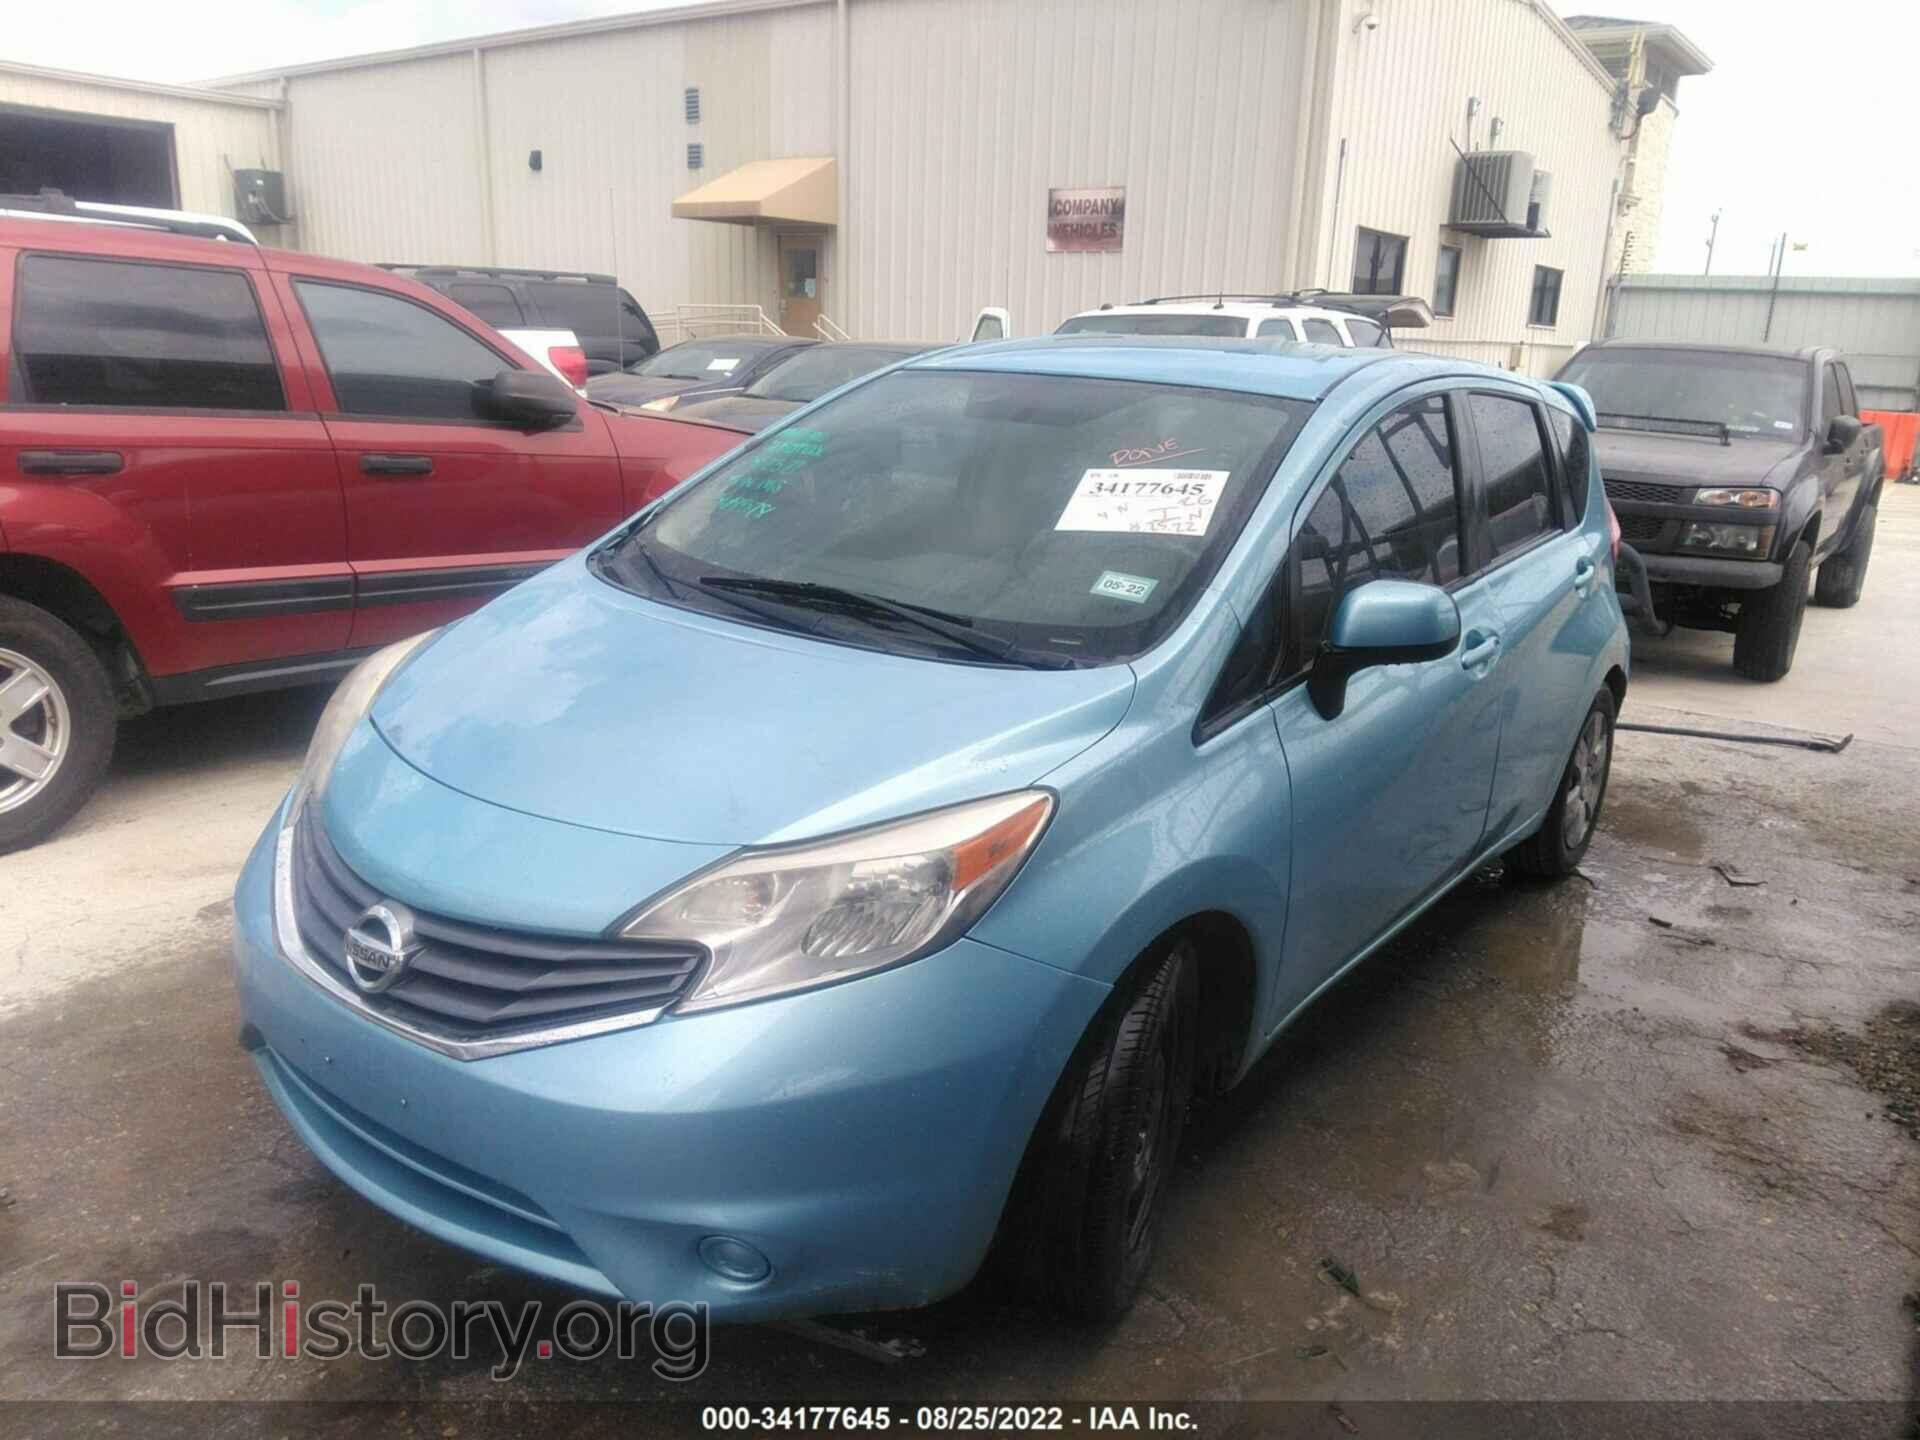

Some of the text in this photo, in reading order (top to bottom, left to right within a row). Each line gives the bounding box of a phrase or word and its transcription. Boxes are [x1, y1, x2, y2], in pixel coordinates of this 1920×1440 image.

[1055, 198, 1119, 216] COMPANY
[1054, 222, 1118, 240] VEHICLES
[1089, 482, 1206, 496] 34177645
[1103, 580, 1145, 595] 05-22
